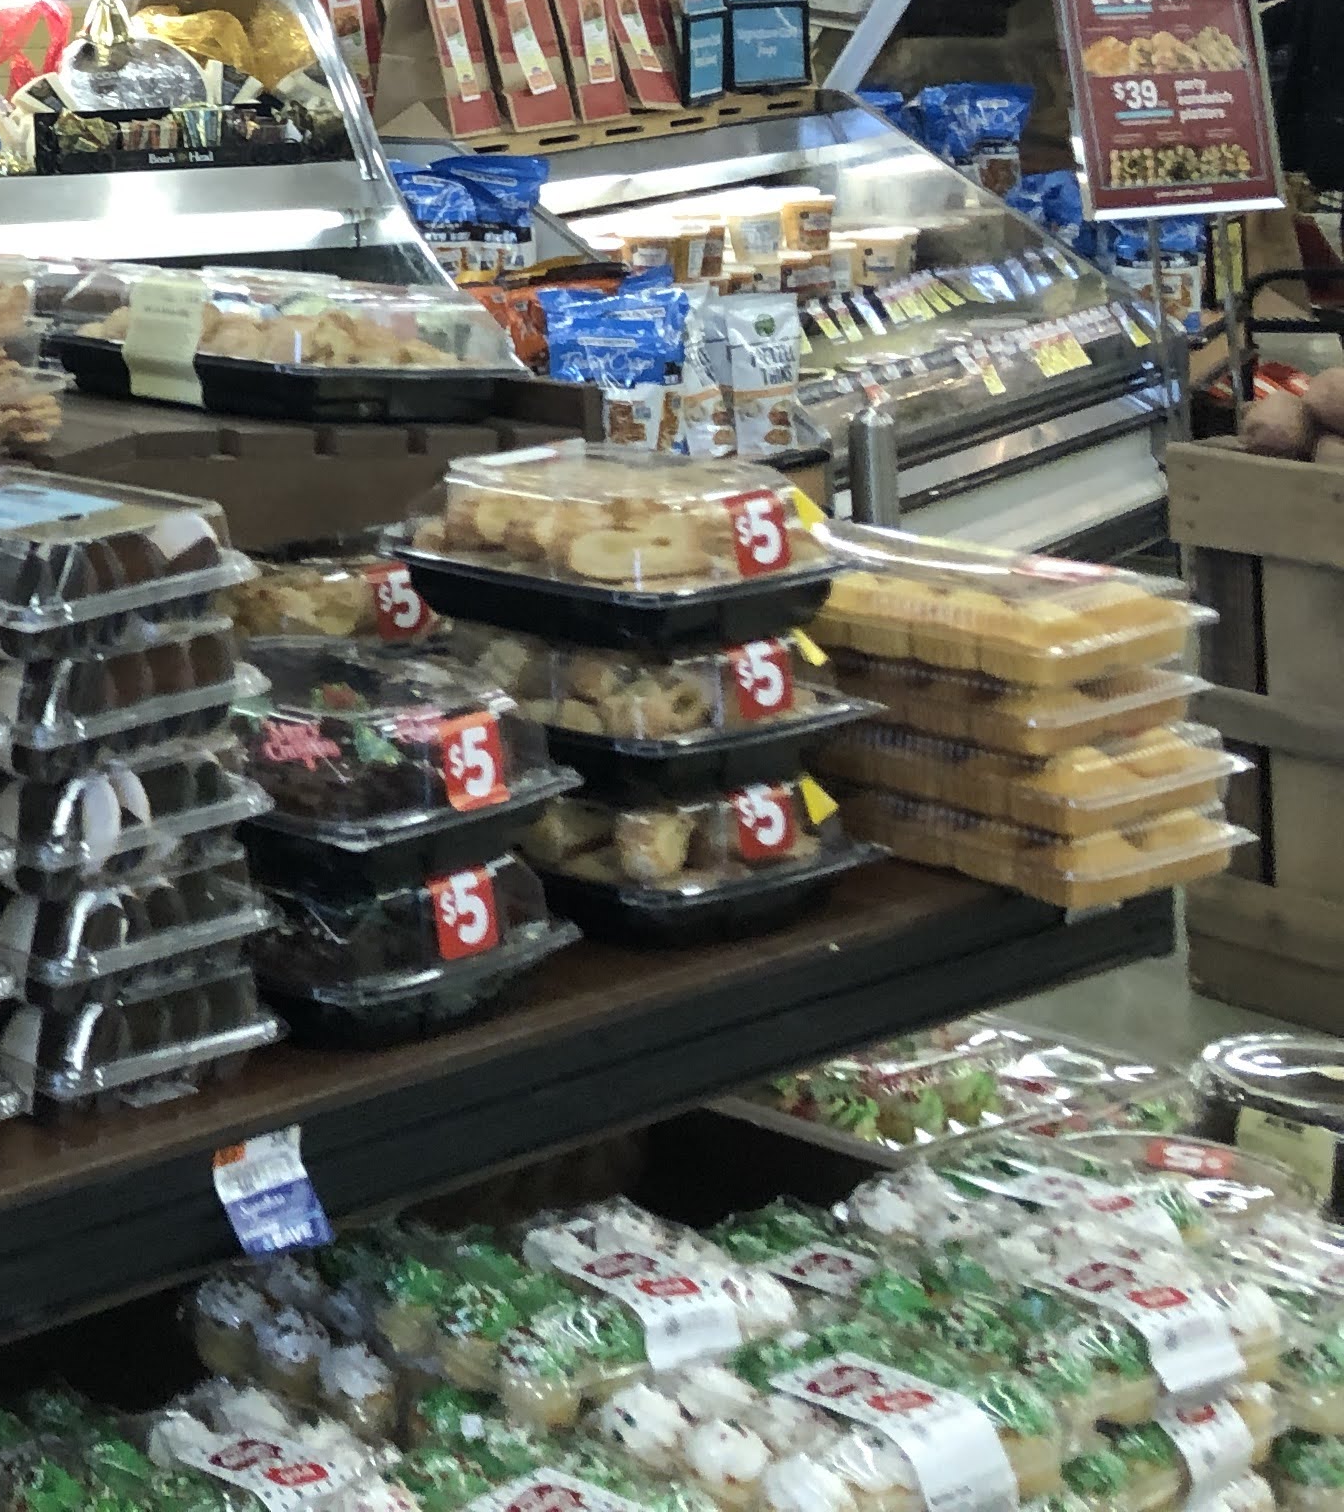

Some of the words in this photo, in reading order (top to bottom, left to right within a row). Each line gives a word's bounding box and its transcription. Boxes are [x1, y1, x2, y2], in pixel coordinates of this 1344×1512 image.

[1112, 79, 1159, 110] $39
[733, 492, 786, 568] $5
[378, 571, 425, 631] $5
[737, 638, 787, 710] $5
[448, 726, 498, 799] $5
[438, 867, 491, 947] $5
